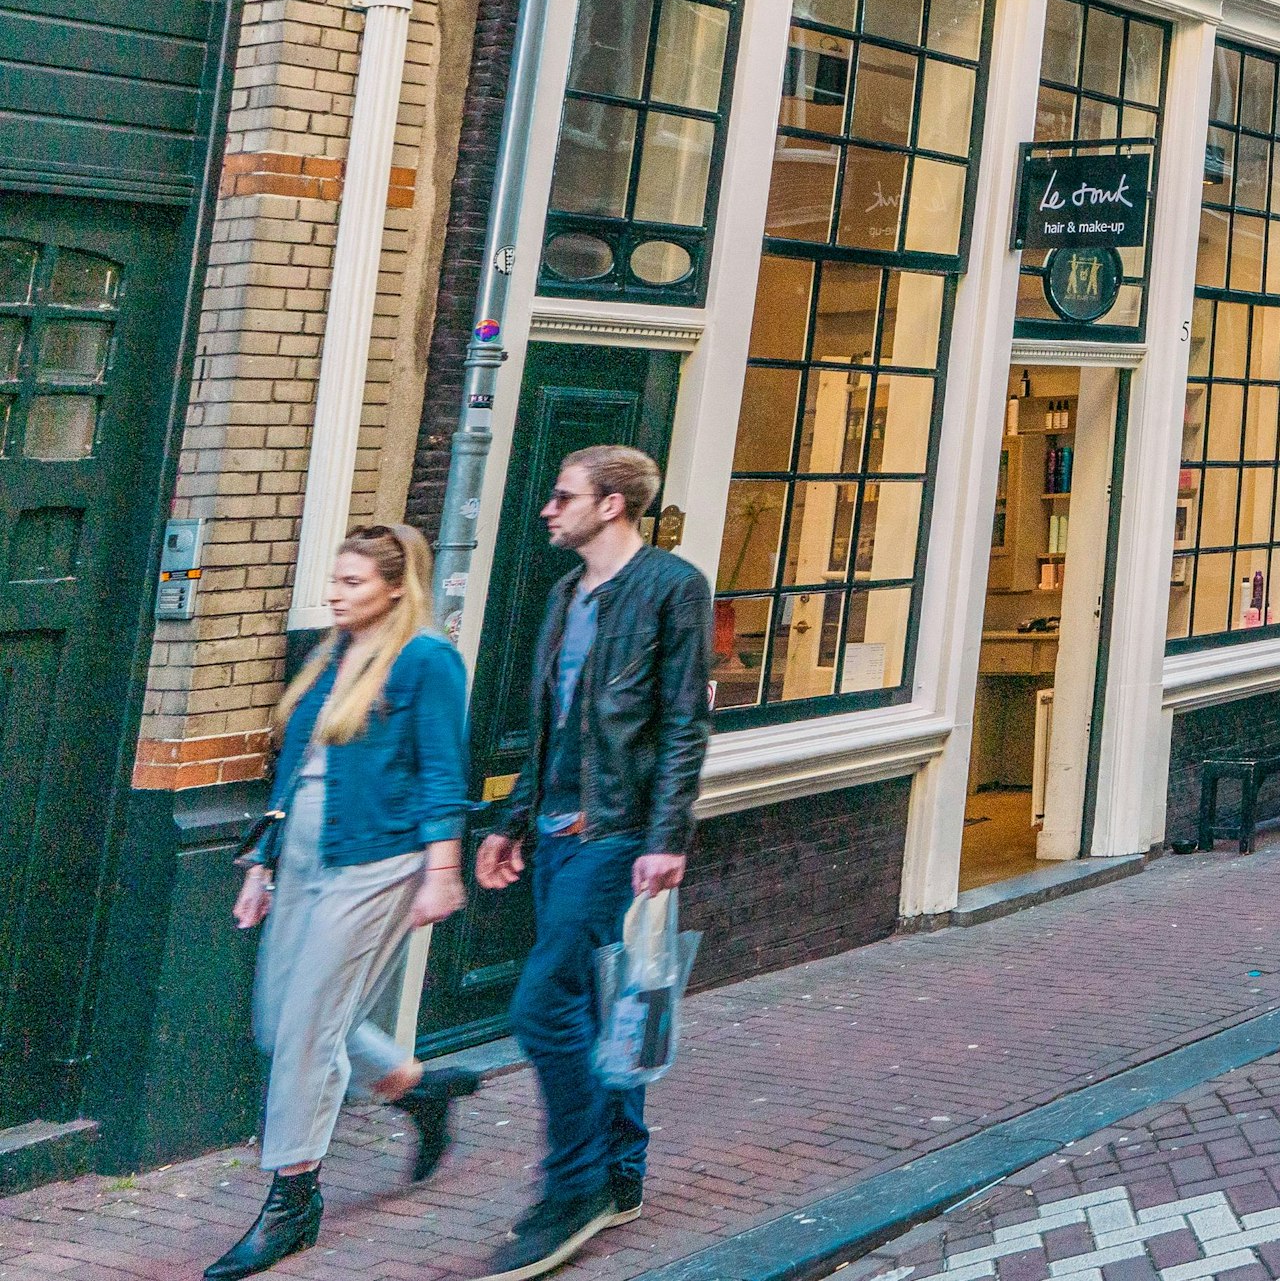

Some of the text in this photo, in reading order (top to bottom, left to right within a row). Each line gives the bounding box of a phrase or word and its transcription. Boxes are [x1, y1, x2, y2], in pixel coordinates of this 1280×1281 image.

[1044, 221, 1125, 235] hair & make-up
[1180, 321, 1190, 342] 5
